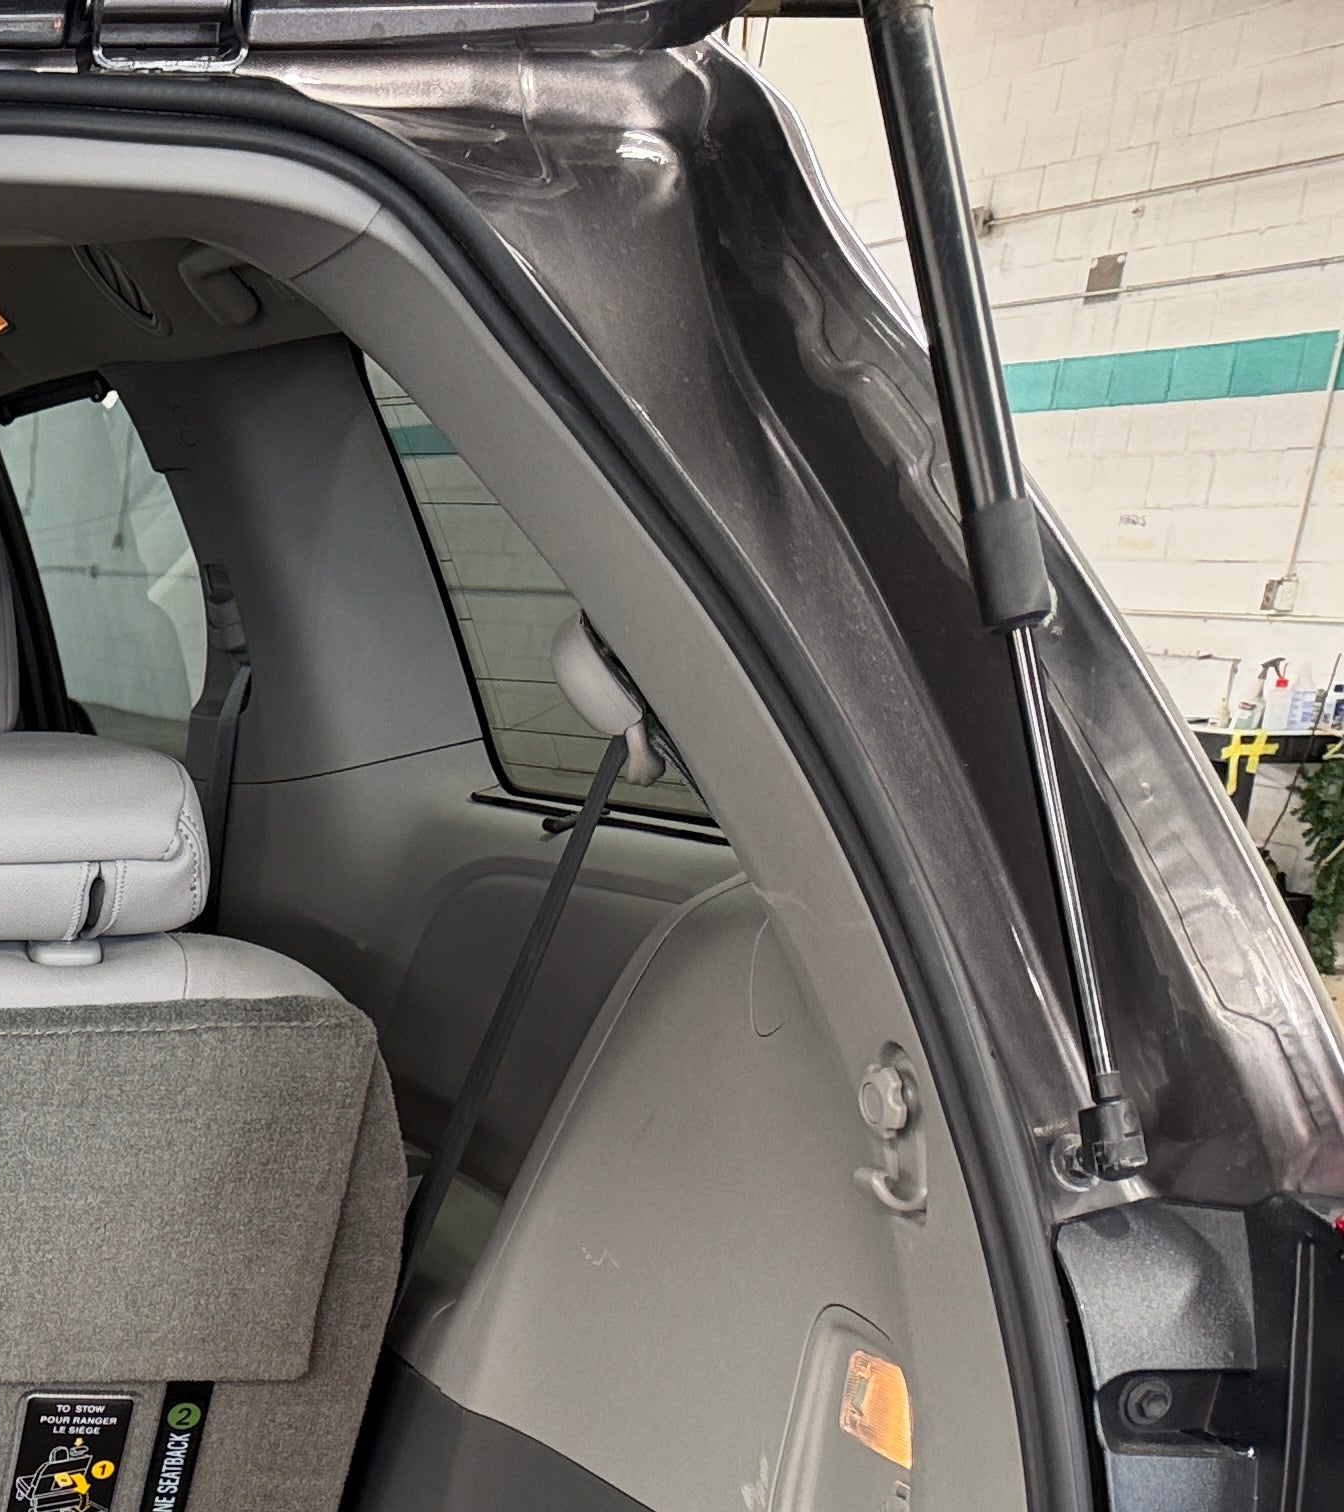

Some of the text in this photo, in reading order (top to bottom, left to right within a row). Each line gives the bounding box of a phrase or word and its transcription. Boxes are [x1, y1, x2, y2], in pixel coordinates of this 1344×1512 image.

[56, 1404, 106, 1414] TO STOW
[40, 1416, 117, 1426] POUR RANGER
[175, 1407, 192, 1426] 2
[52, 1424, 101, 1435] LE SIÈGE
[156, 1432, 192, 1494] SEATBACK
[98, 1464, 108, 1476] 1
